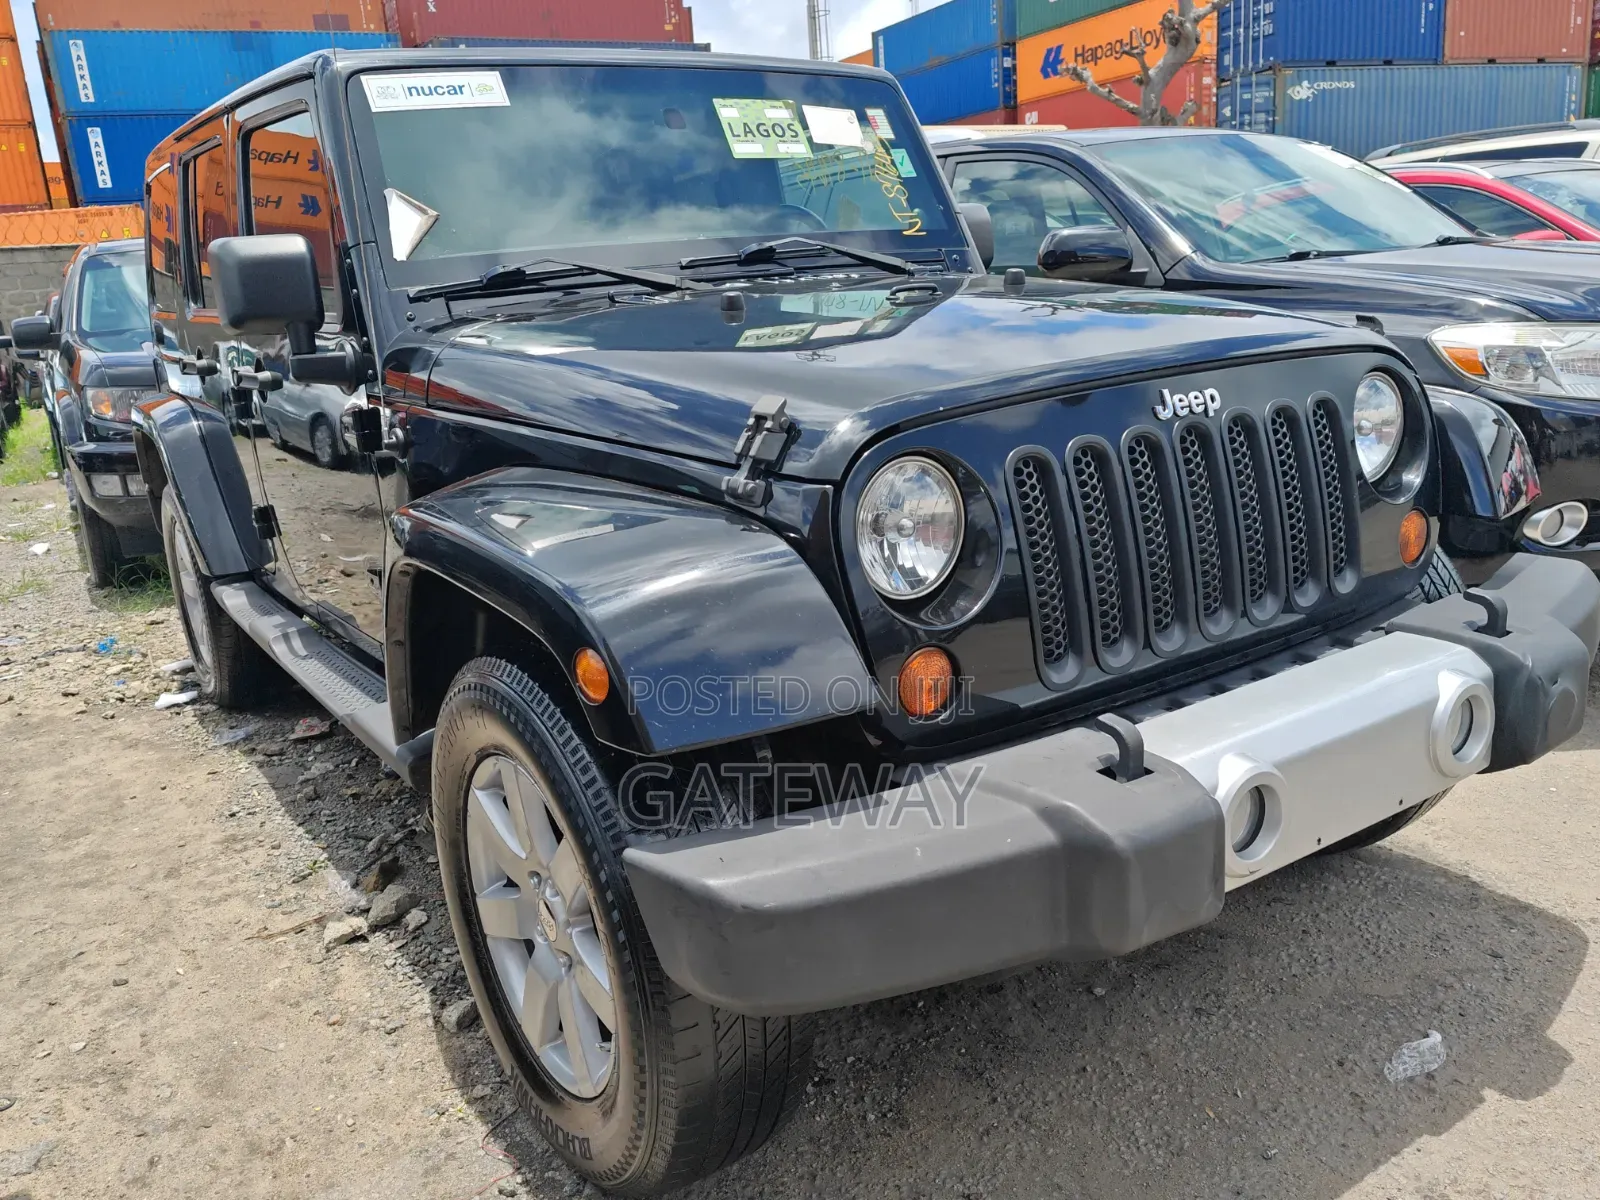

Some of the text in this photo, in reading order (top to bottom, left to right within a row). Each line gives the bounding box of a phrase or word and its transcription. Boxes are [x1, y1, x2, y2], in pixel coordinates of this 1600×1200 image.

[1073, 26, 1167, 67] Hapag-Lloy
[75, 53, 90, 101] ARKAS
[406, 83, 466, 97] nucar
[1313, 80, 1356, 90] CRONOS
[727, 122, 799, 139] LAGOS
[93, 140, 108, 187] ARKAS
[1151, 388, 1221, 420] Jeep
